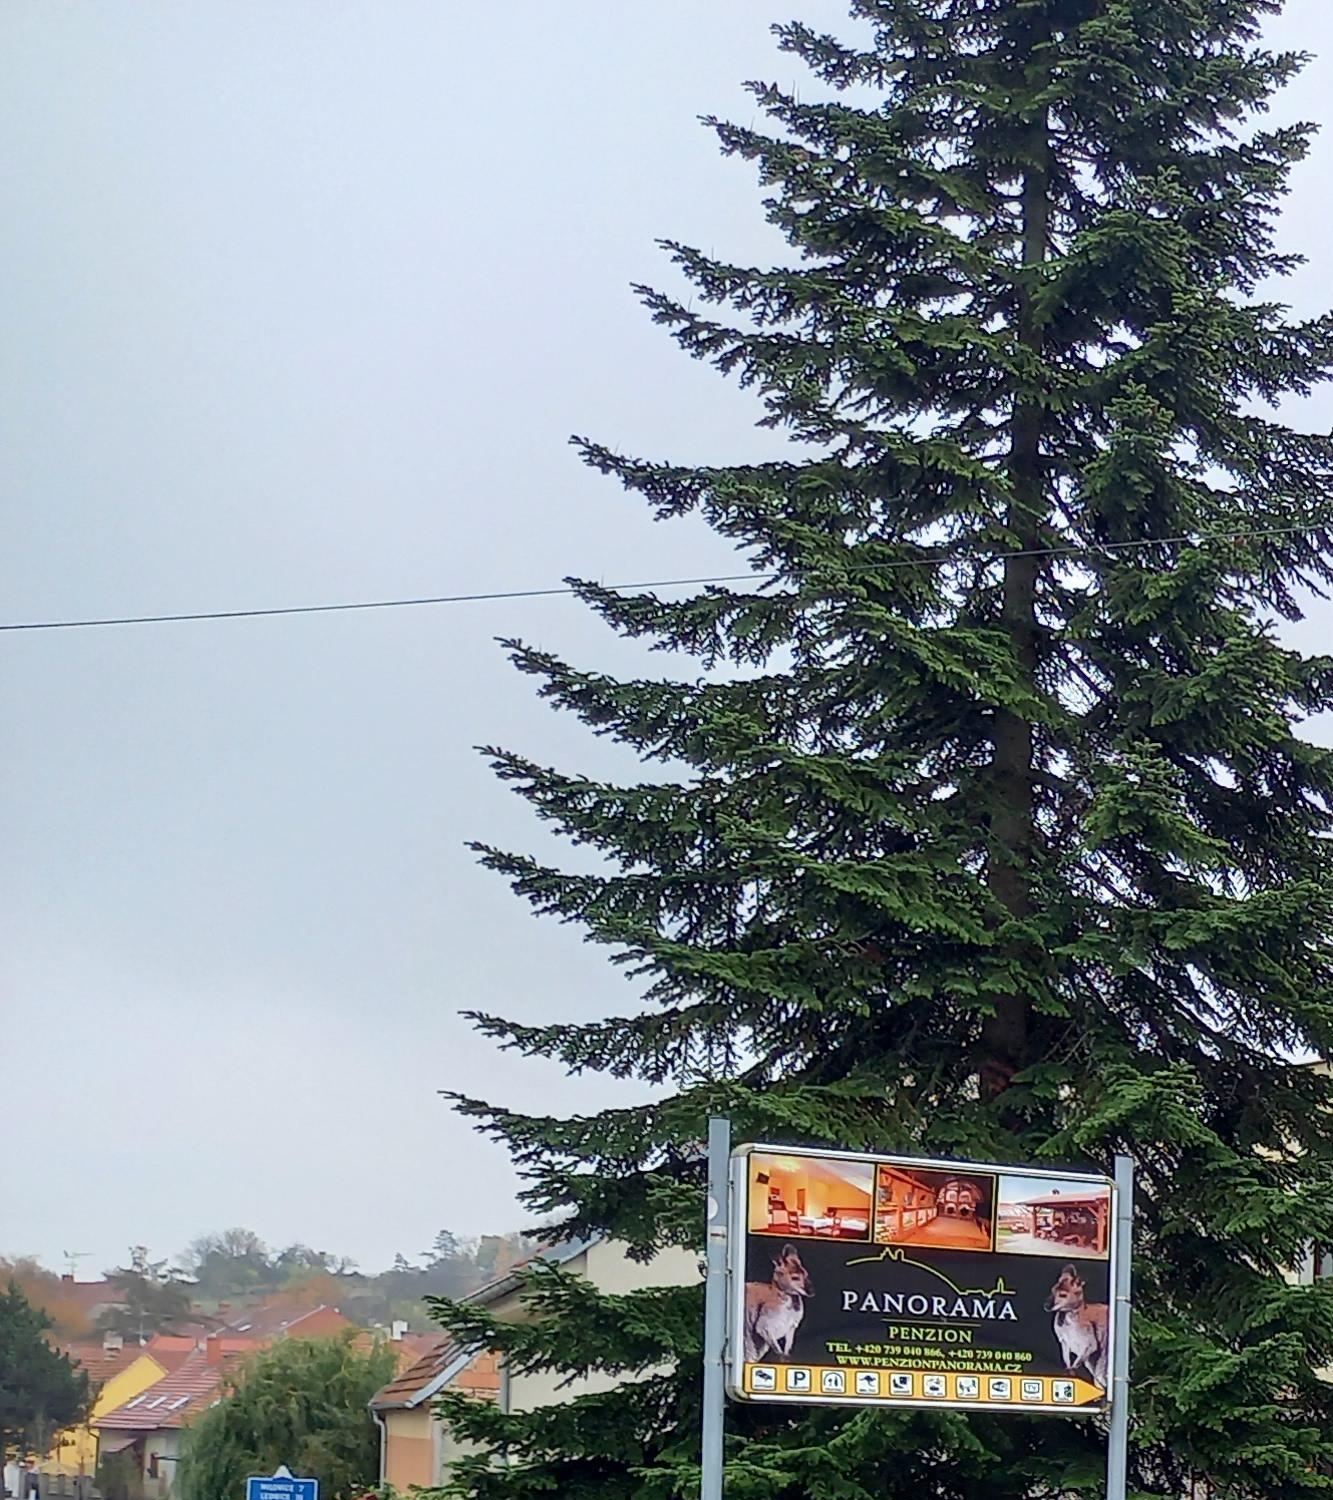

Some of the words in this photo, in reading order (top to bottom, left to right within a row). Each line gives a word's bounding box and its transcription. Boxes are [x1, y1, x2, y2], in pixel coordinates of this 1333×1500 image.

[842, 1290, 1017, 1321] PANORAMA
[889, 1326, 973, 1343] PENZION
[855, 1344, 881, 1354] +420
[883, 1345, 901, 1355] 739
[903, 1346, 922, 1356] 040
[948, 1348, 974, 1359] +420
[975, 1350, 993, 1360] 739
[836, 1355, 1023, 1373] WWW.PENZIONPANORAMA.CZ
